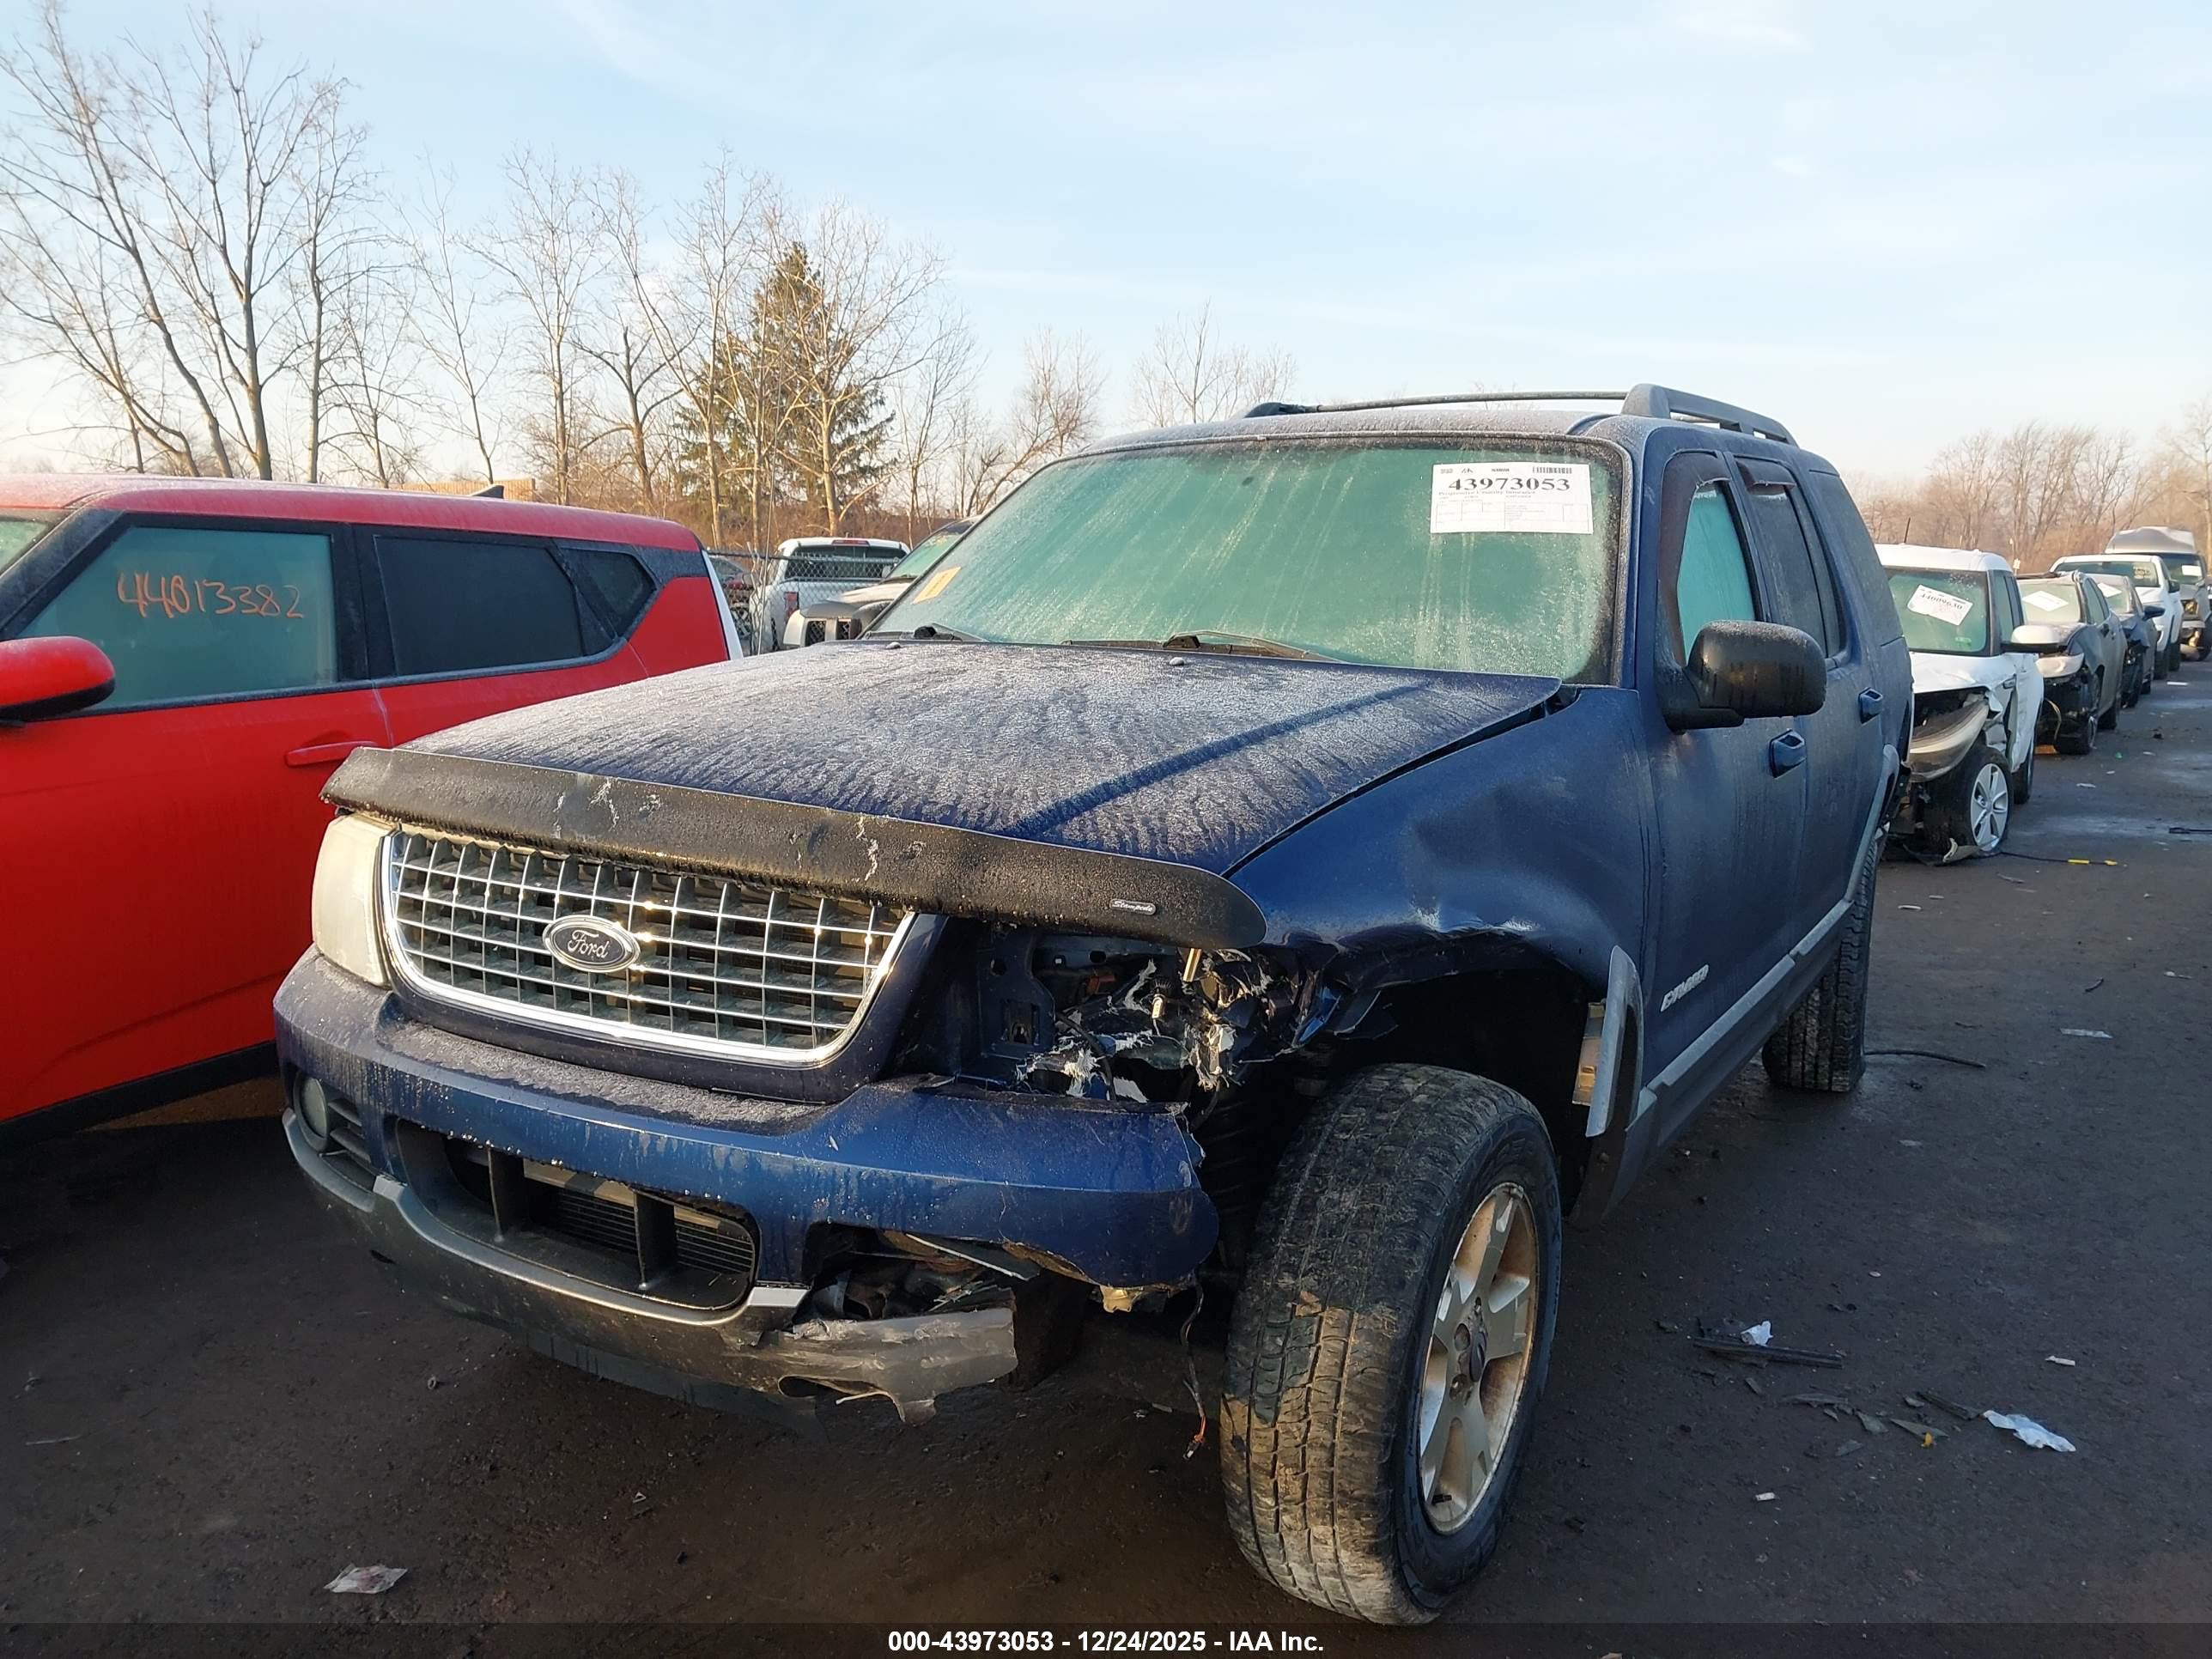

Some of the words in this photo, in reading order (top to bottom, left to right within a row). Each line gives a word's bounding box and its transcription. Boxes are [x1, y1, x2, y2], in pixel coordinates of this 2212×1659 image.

[1448, 477, 1571, 491] 43973053
[117, 571, 304, 618] 44013382
[567, 929, 611, 958] Ford
